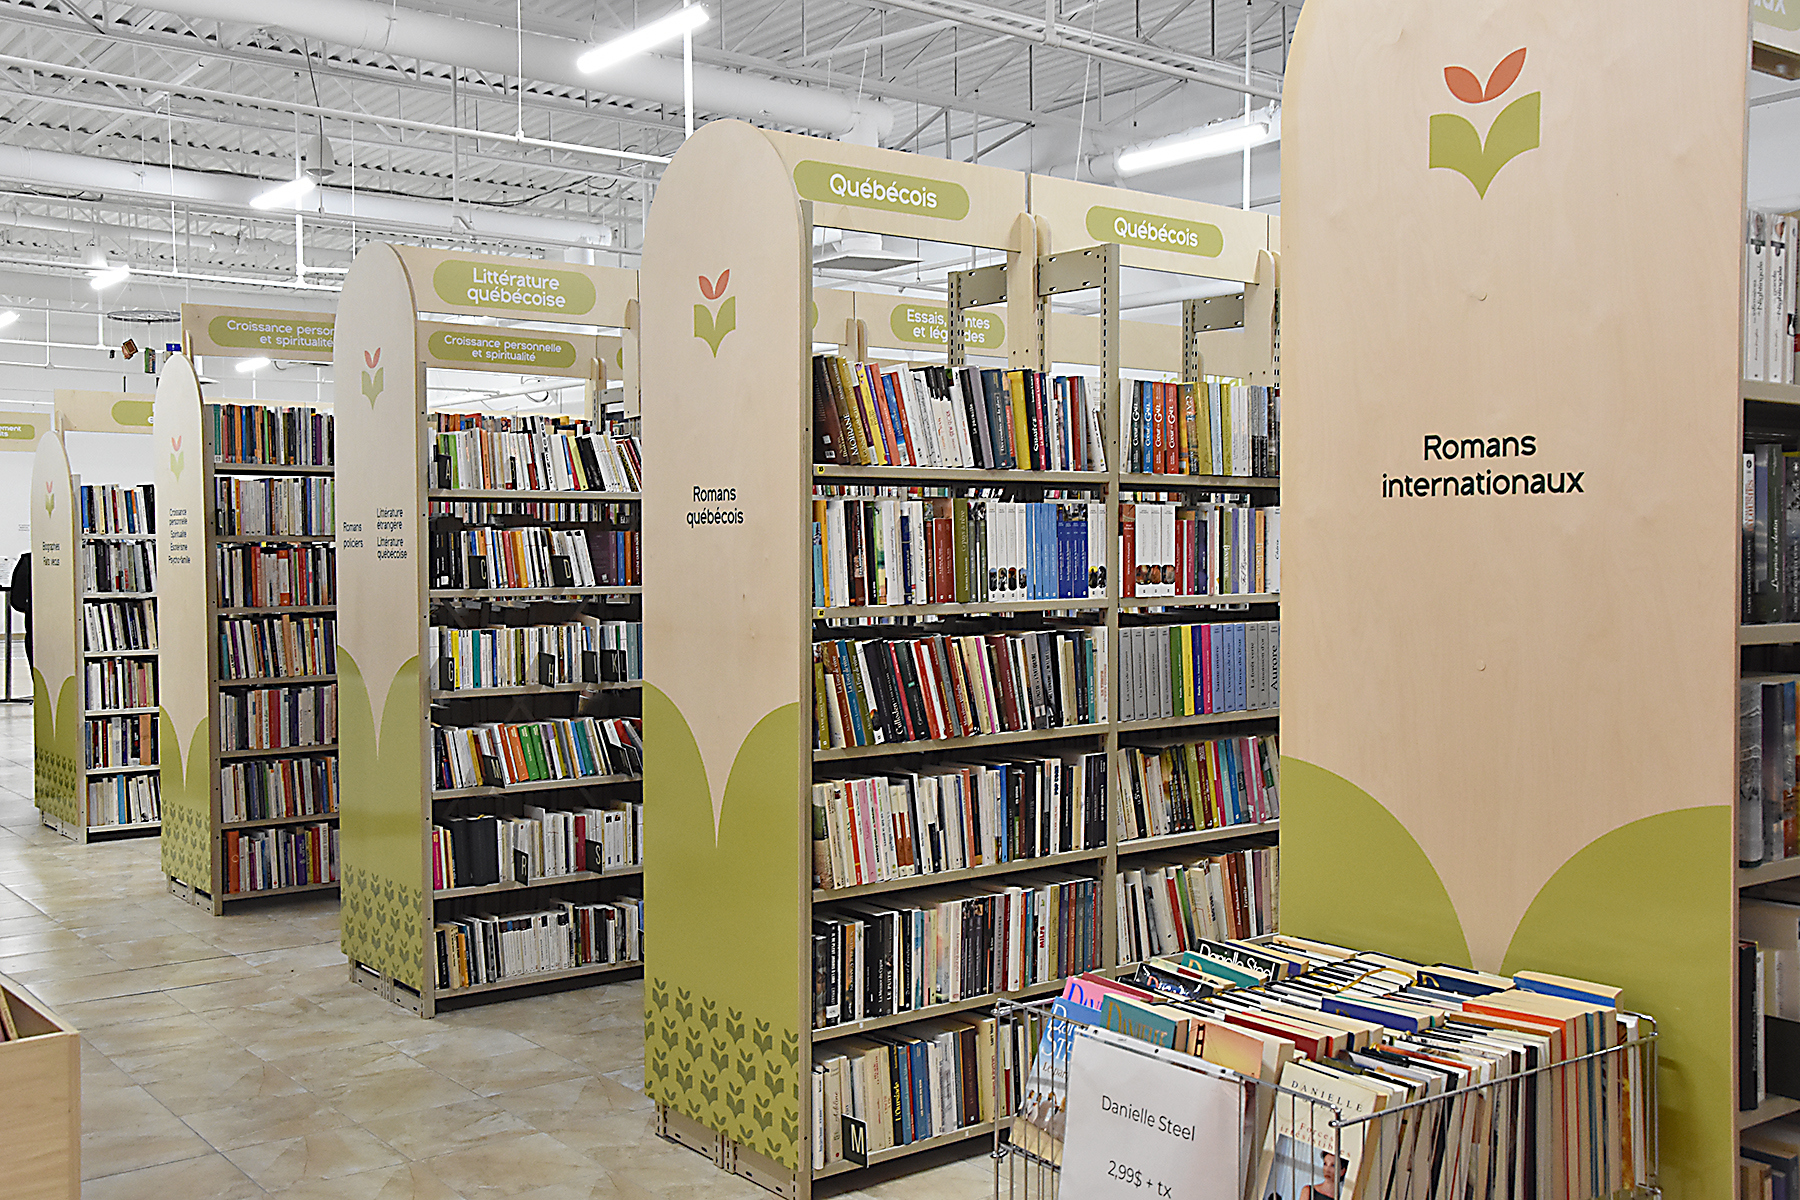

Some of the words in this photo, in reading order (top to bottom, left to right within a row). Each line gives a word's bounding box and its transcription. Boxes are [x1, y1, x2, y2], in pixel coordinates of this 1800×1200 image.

[828, 173, 938, 208] Québécois
[1114, 217, 1199, 247] Québécois
[473, 267, 560, 291] Littérature
[467, 286, 566, 308] québécoise
[226, 320, 293, 333] Croissance
[906, 308, 947, 327] Essais,
[259, 335, 271, 344] et
[913, 327, 926, 338] et
[444, 335, 501, 348] Croissance
[503, 339, 562, 354] personnelle
[471, 349, 482, 358] et
[485, 349, 536, 362] spiritualité
[1423, 434, 1537, 461] Romans
[693, 485, 737, 502] Romans
[1381, 468, 1586, 498] internationaux
[343, 521, 362, 532] Romans
[686, 506, 744, 529] québécois
[343, 537, 364, 550] policiers
[480, 558, 487, 580] C
[563, 558, 572, 579] D
[448, 660, 454, 682] G
[1270, 644, 1278, 690] Aurore
[521, 855, 527, 876] R
[595, 845, 601, 865] S
[1291, 1080, 1364, 1113] DANIELLE
[1101, 1094, 1156, 1127] Danielle
[1158, 1114, 1197, 1142] Steel
[850, 1124, 865, 1155] M
[1108, 1159, 1143, 1189] 2,99$
[1146, 1178, 1154, 1188] +
[1157, 1180, 1173, 1200] tx
